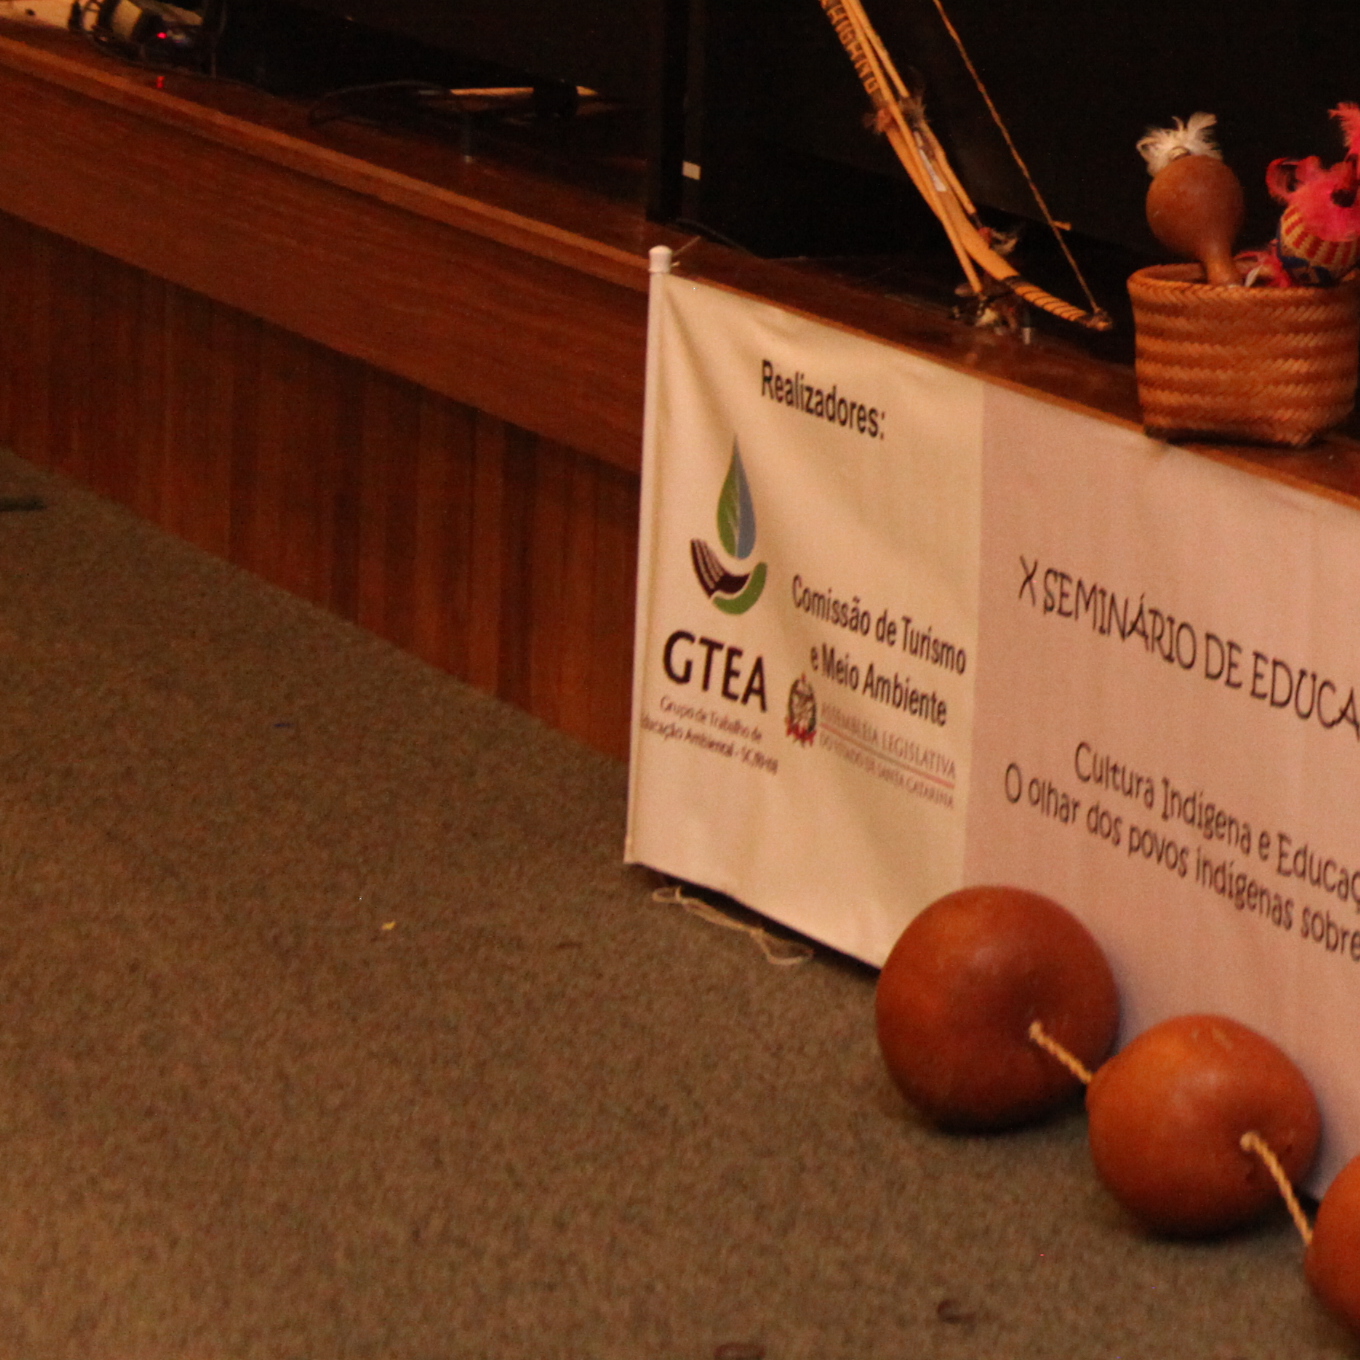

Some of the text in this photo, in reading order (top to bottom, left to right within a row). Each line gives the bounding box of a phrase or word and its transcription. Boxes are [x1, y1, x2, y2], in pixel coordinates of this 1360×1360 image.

[761, 358, 886, 440] Realizadores:
[662, 629, 768, 714] GTEA
[792, 574, 967, 675] Comissão de Turismo
[1018, 555, 1038, 607] X
[1043, 567, 1197, 670] SEMINÁRIO
[1204, 632, 1242, 689] DE
[811, 643, 948, 728] e Meio Ambiente
[1004, 762, 1023, 804] O
[1028, 777, 1080, 825] olhar
[1087, 800, 1122, 847] dos
[1128, 824, 1189, 879] povos
[1195, 846, 1295, 931] indígenas
[1074, 741, 1155, 809] Cultura
[1258, 830, 1271, 861] e
